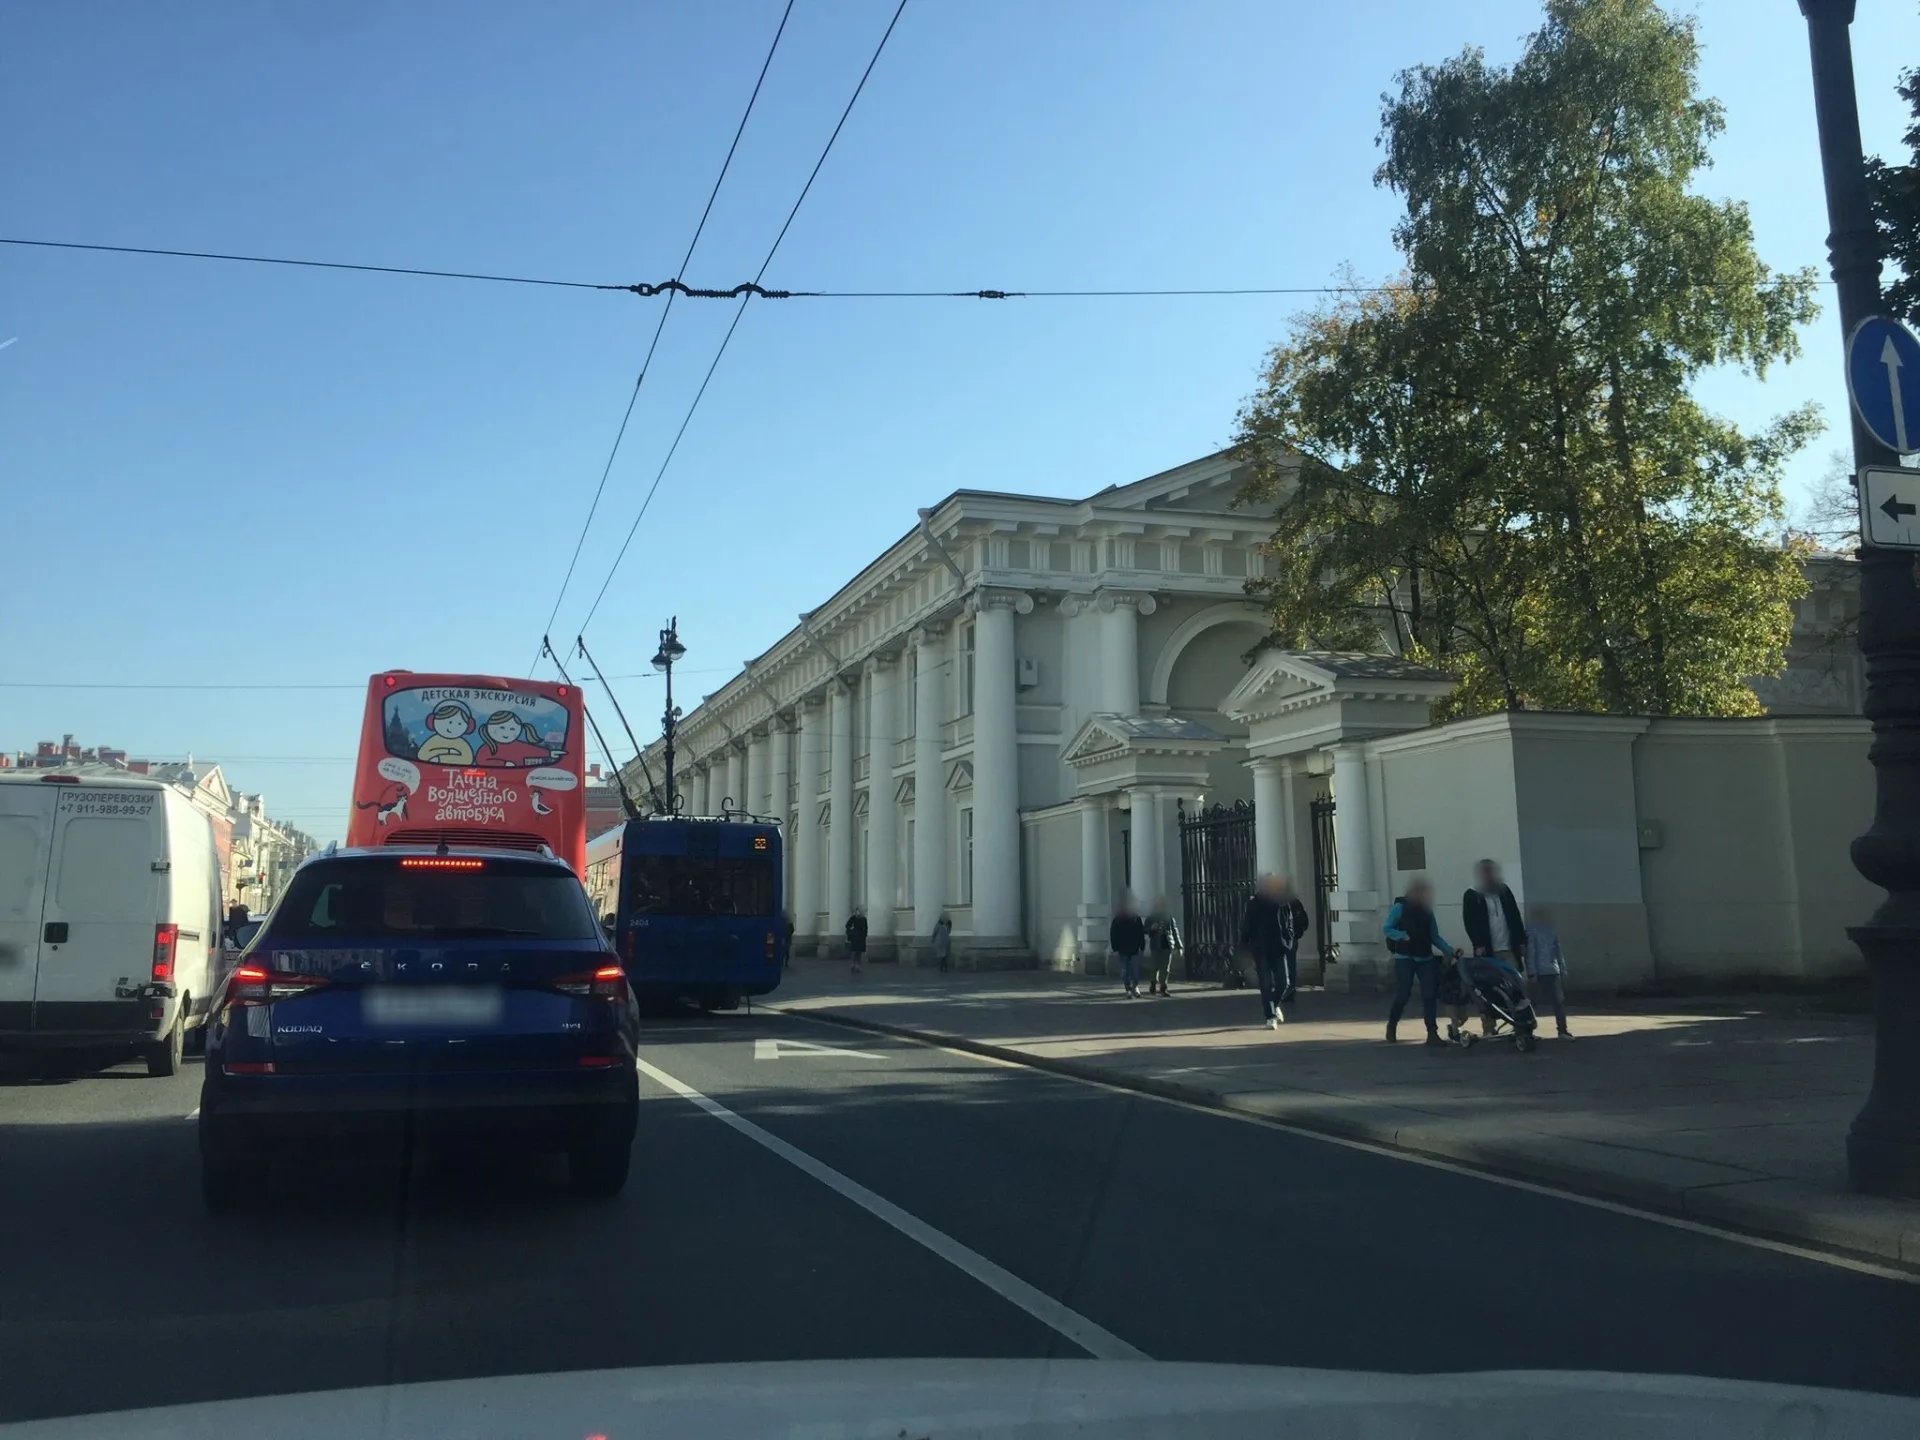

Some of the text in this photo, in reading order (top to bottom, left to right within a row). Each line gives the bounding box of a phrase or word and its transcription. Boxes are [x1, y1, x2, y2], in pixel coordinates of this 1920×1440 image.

[421, 689, 537, 707] ДЕТСКАЯ ЭКСКУРСИЯ
[61, 791, 154, 804] ГРУЗОПЕРЕВОЗКИ
[60, 804, 152, 815] +7 911-988-99-57
[277, 1025, 323, 1034] KODIAQ
